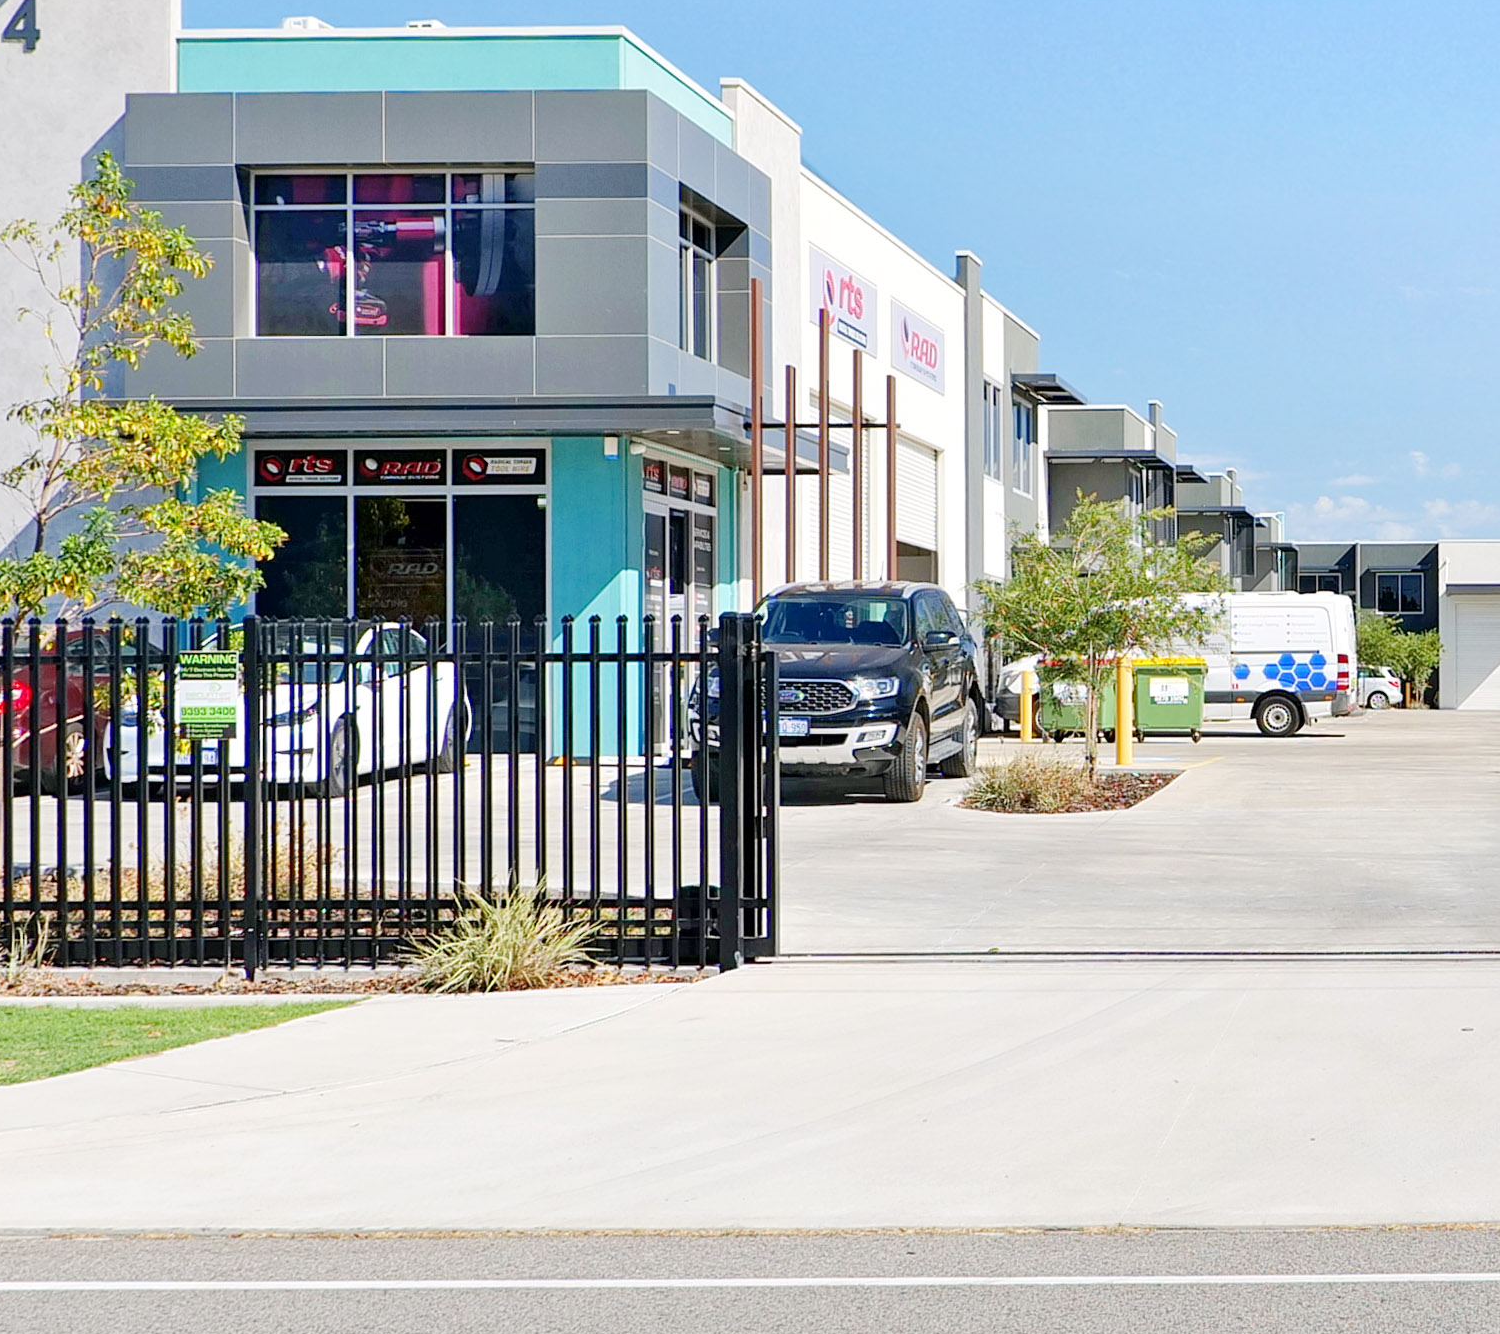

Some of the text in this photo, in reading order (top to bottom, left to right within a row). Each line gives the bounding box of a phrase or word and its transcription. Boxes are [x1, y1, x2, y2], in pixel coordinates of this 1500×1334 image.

[839, 275, 863, 320] rts
[911, 331, 938, 369] RAD
[288, 454, 333, 473] rts
[180, 653, 236, 664] WARNING
[181, 707, 206, 716] 9393
